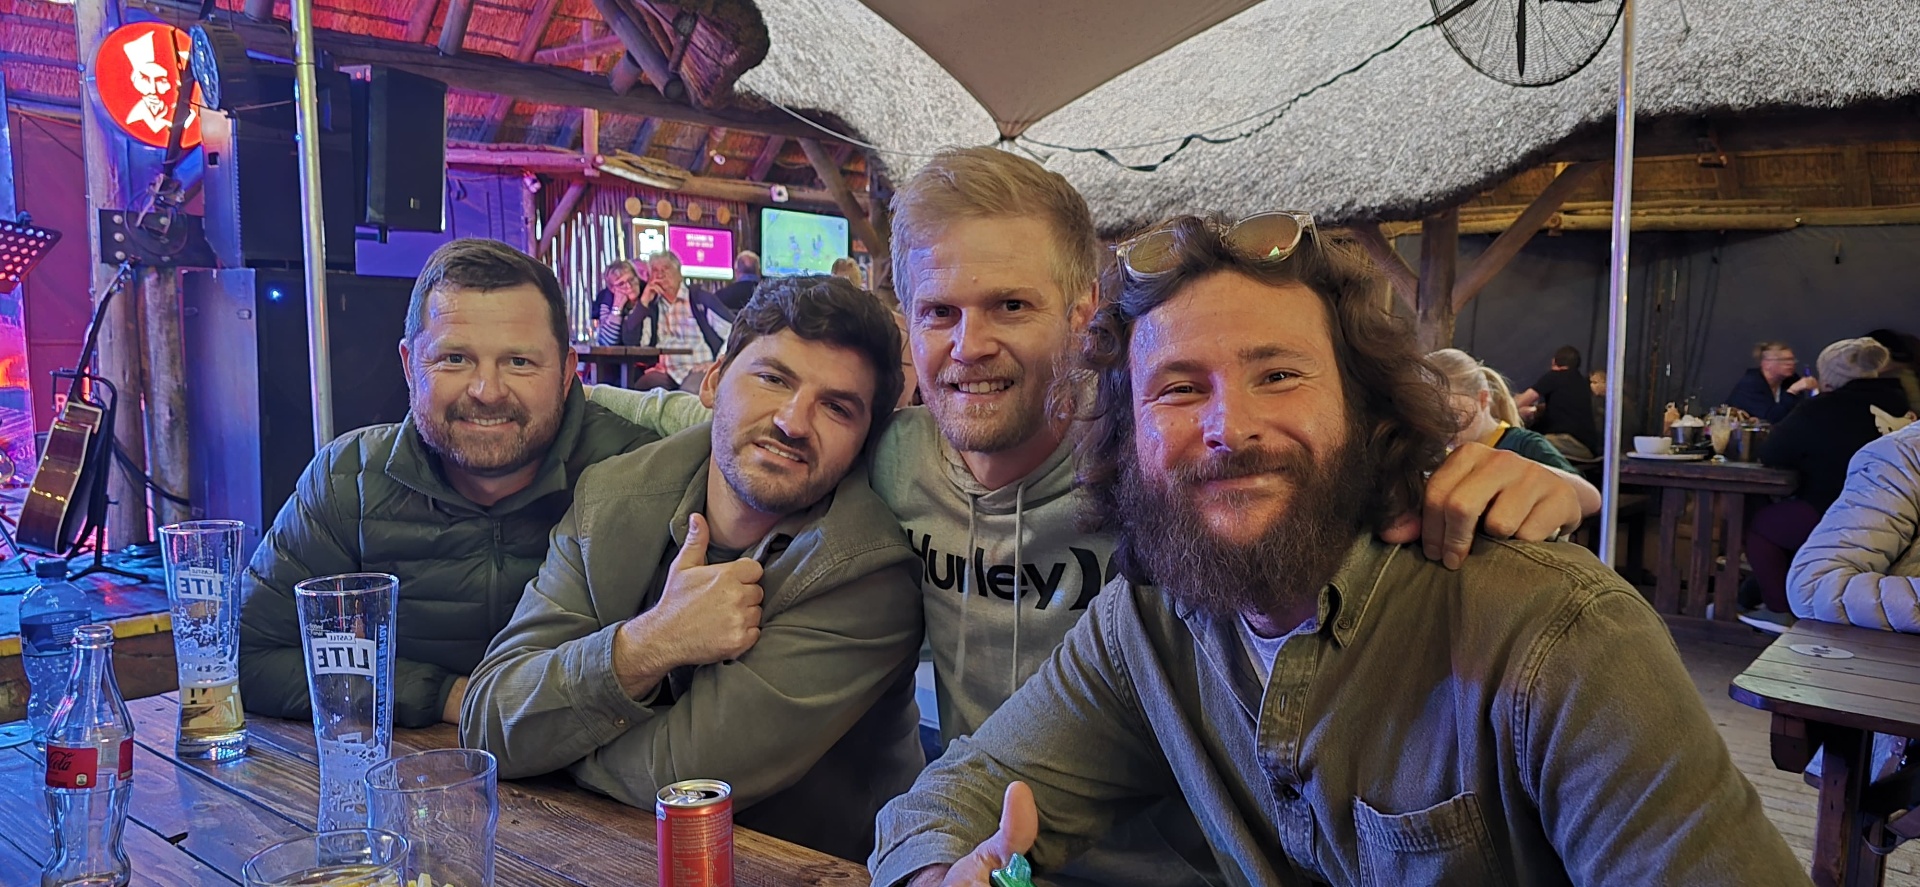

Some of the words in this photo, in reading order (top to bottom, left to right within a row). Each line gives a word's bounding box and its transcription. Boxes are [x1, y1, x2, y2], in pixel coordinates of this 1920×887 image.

[907, 529, 1066, 611] Hurley
[378, 624, 388, 656] ENJOY
[377, 657, 387, 703] REFRESH
